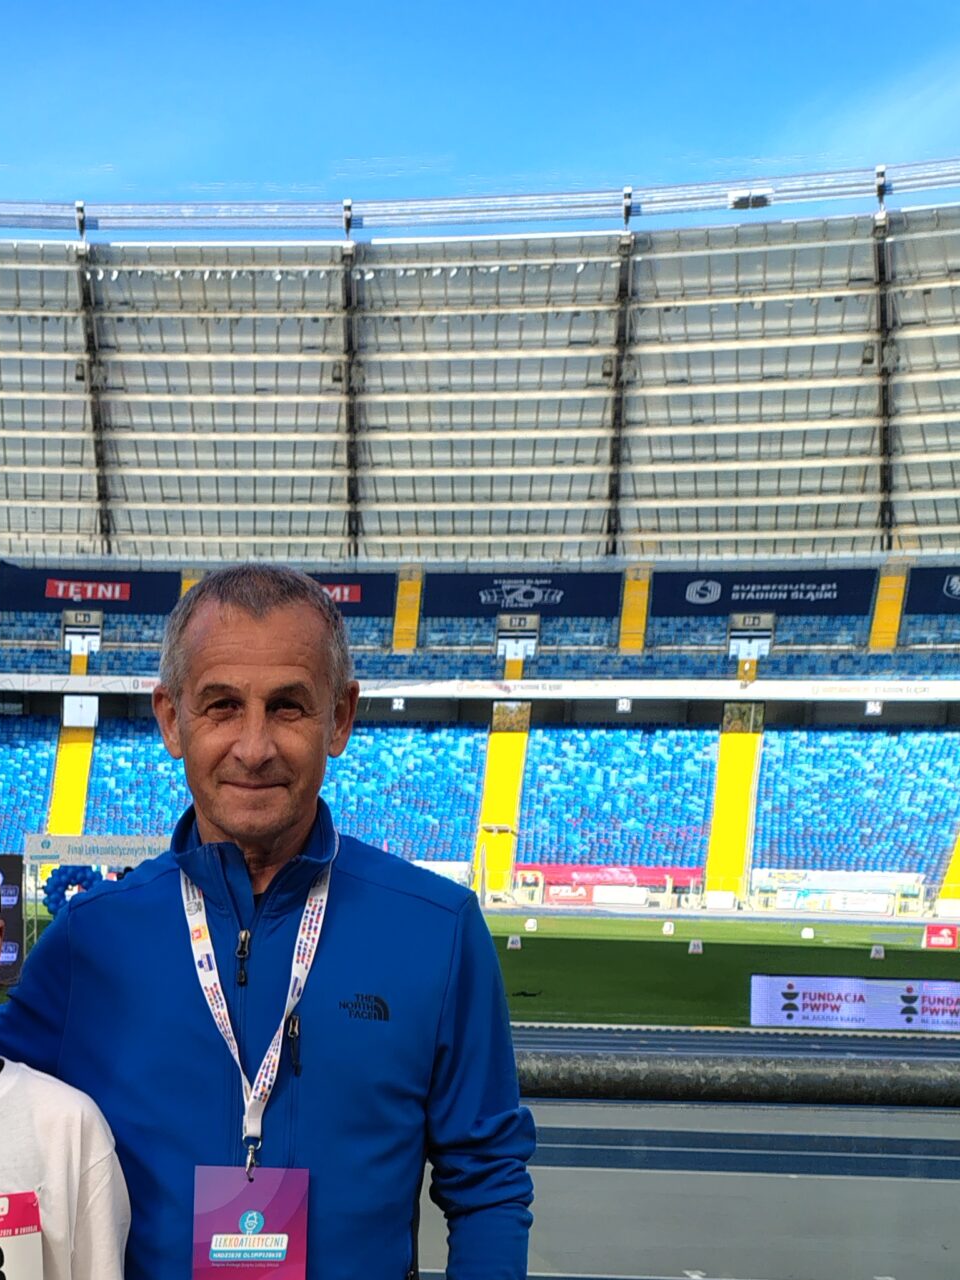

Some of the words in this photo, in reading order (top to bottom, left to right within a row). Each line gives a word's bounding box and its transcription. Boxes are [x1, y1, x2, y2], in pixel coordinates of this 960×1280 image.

[55, 580, 122, 602] TĘTNI
[732, 581, 837, 592] superauto.pl
[731, 591, 788, 600] STADION
[790, 590, 837, 601] ŚLĄSKI
[354, 993, 373, 1002] THE
[801, 991, 866, 1003] FUNDACJA
[338, 1000, 374, 1010] NORTH
[801, 1002, 842, 1013] PWPW
[348, 1009, 374, 1020] FACE
[214, 1235, 285, 1248] LEKKOATLETYCZNE
